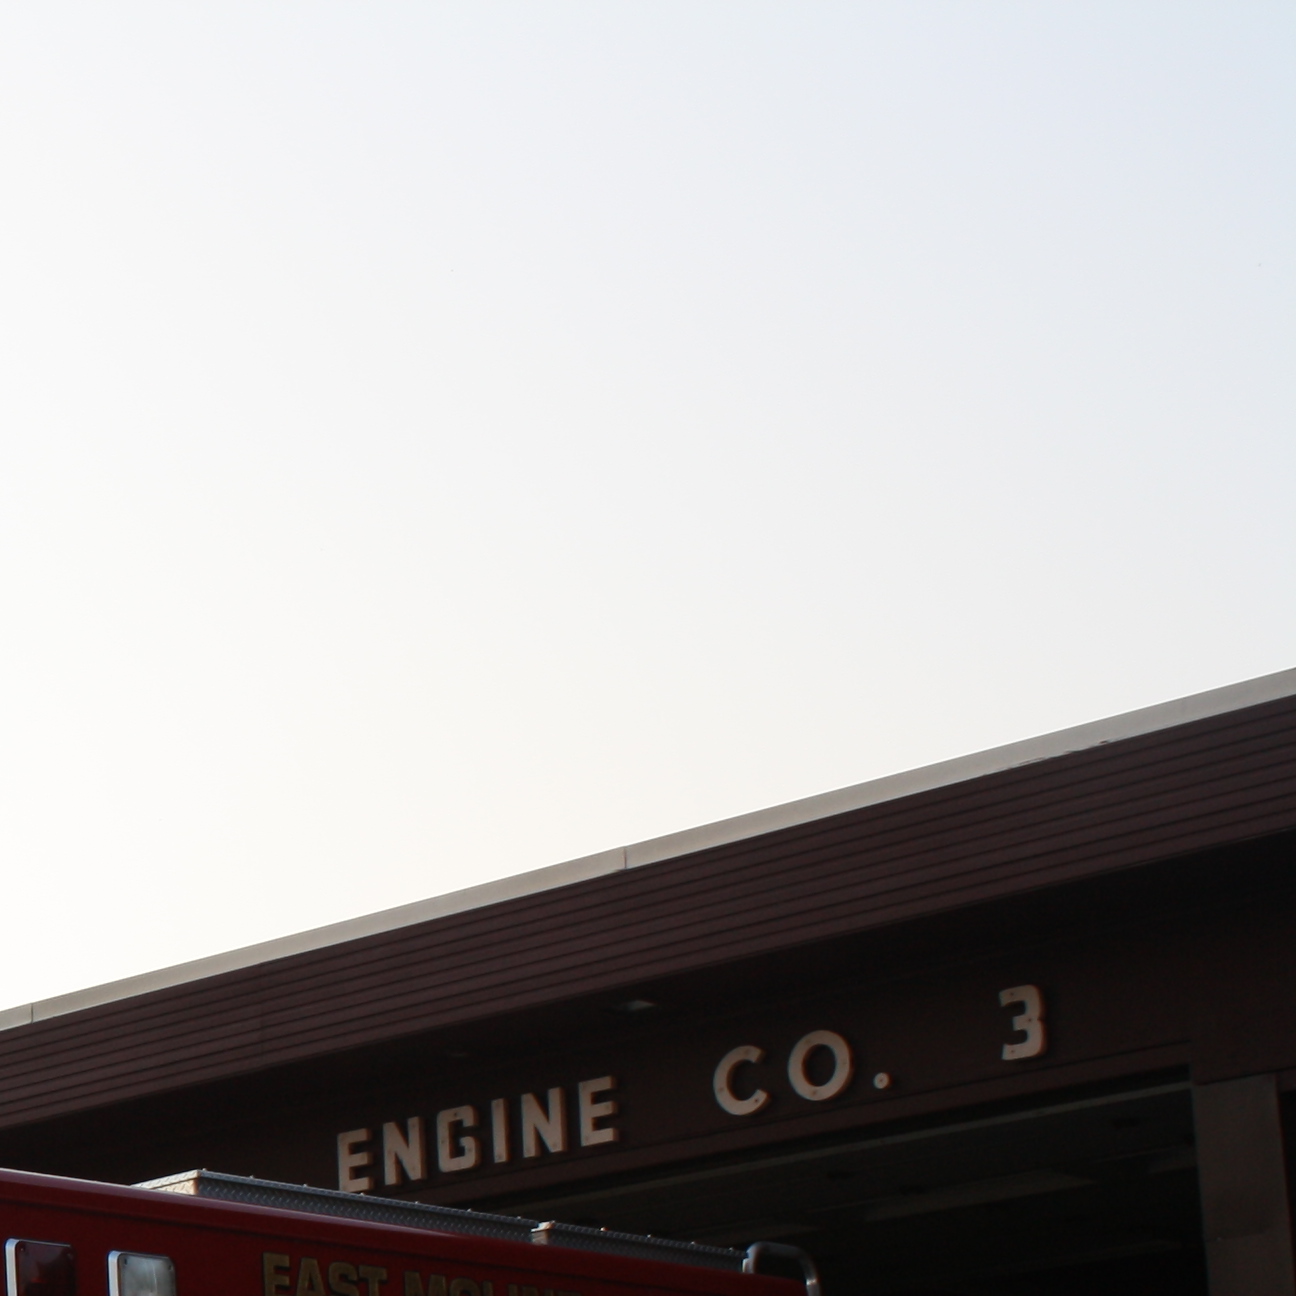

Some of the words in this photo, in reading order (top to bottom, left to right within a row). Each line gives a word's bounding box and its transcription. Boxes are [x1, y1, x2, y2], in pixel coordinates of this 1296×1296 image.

[337, 1075, 620, 1192] ENGINE
[712, 1029, 892, 1116] CO.
[998, 984, 1048, 1061] 3
